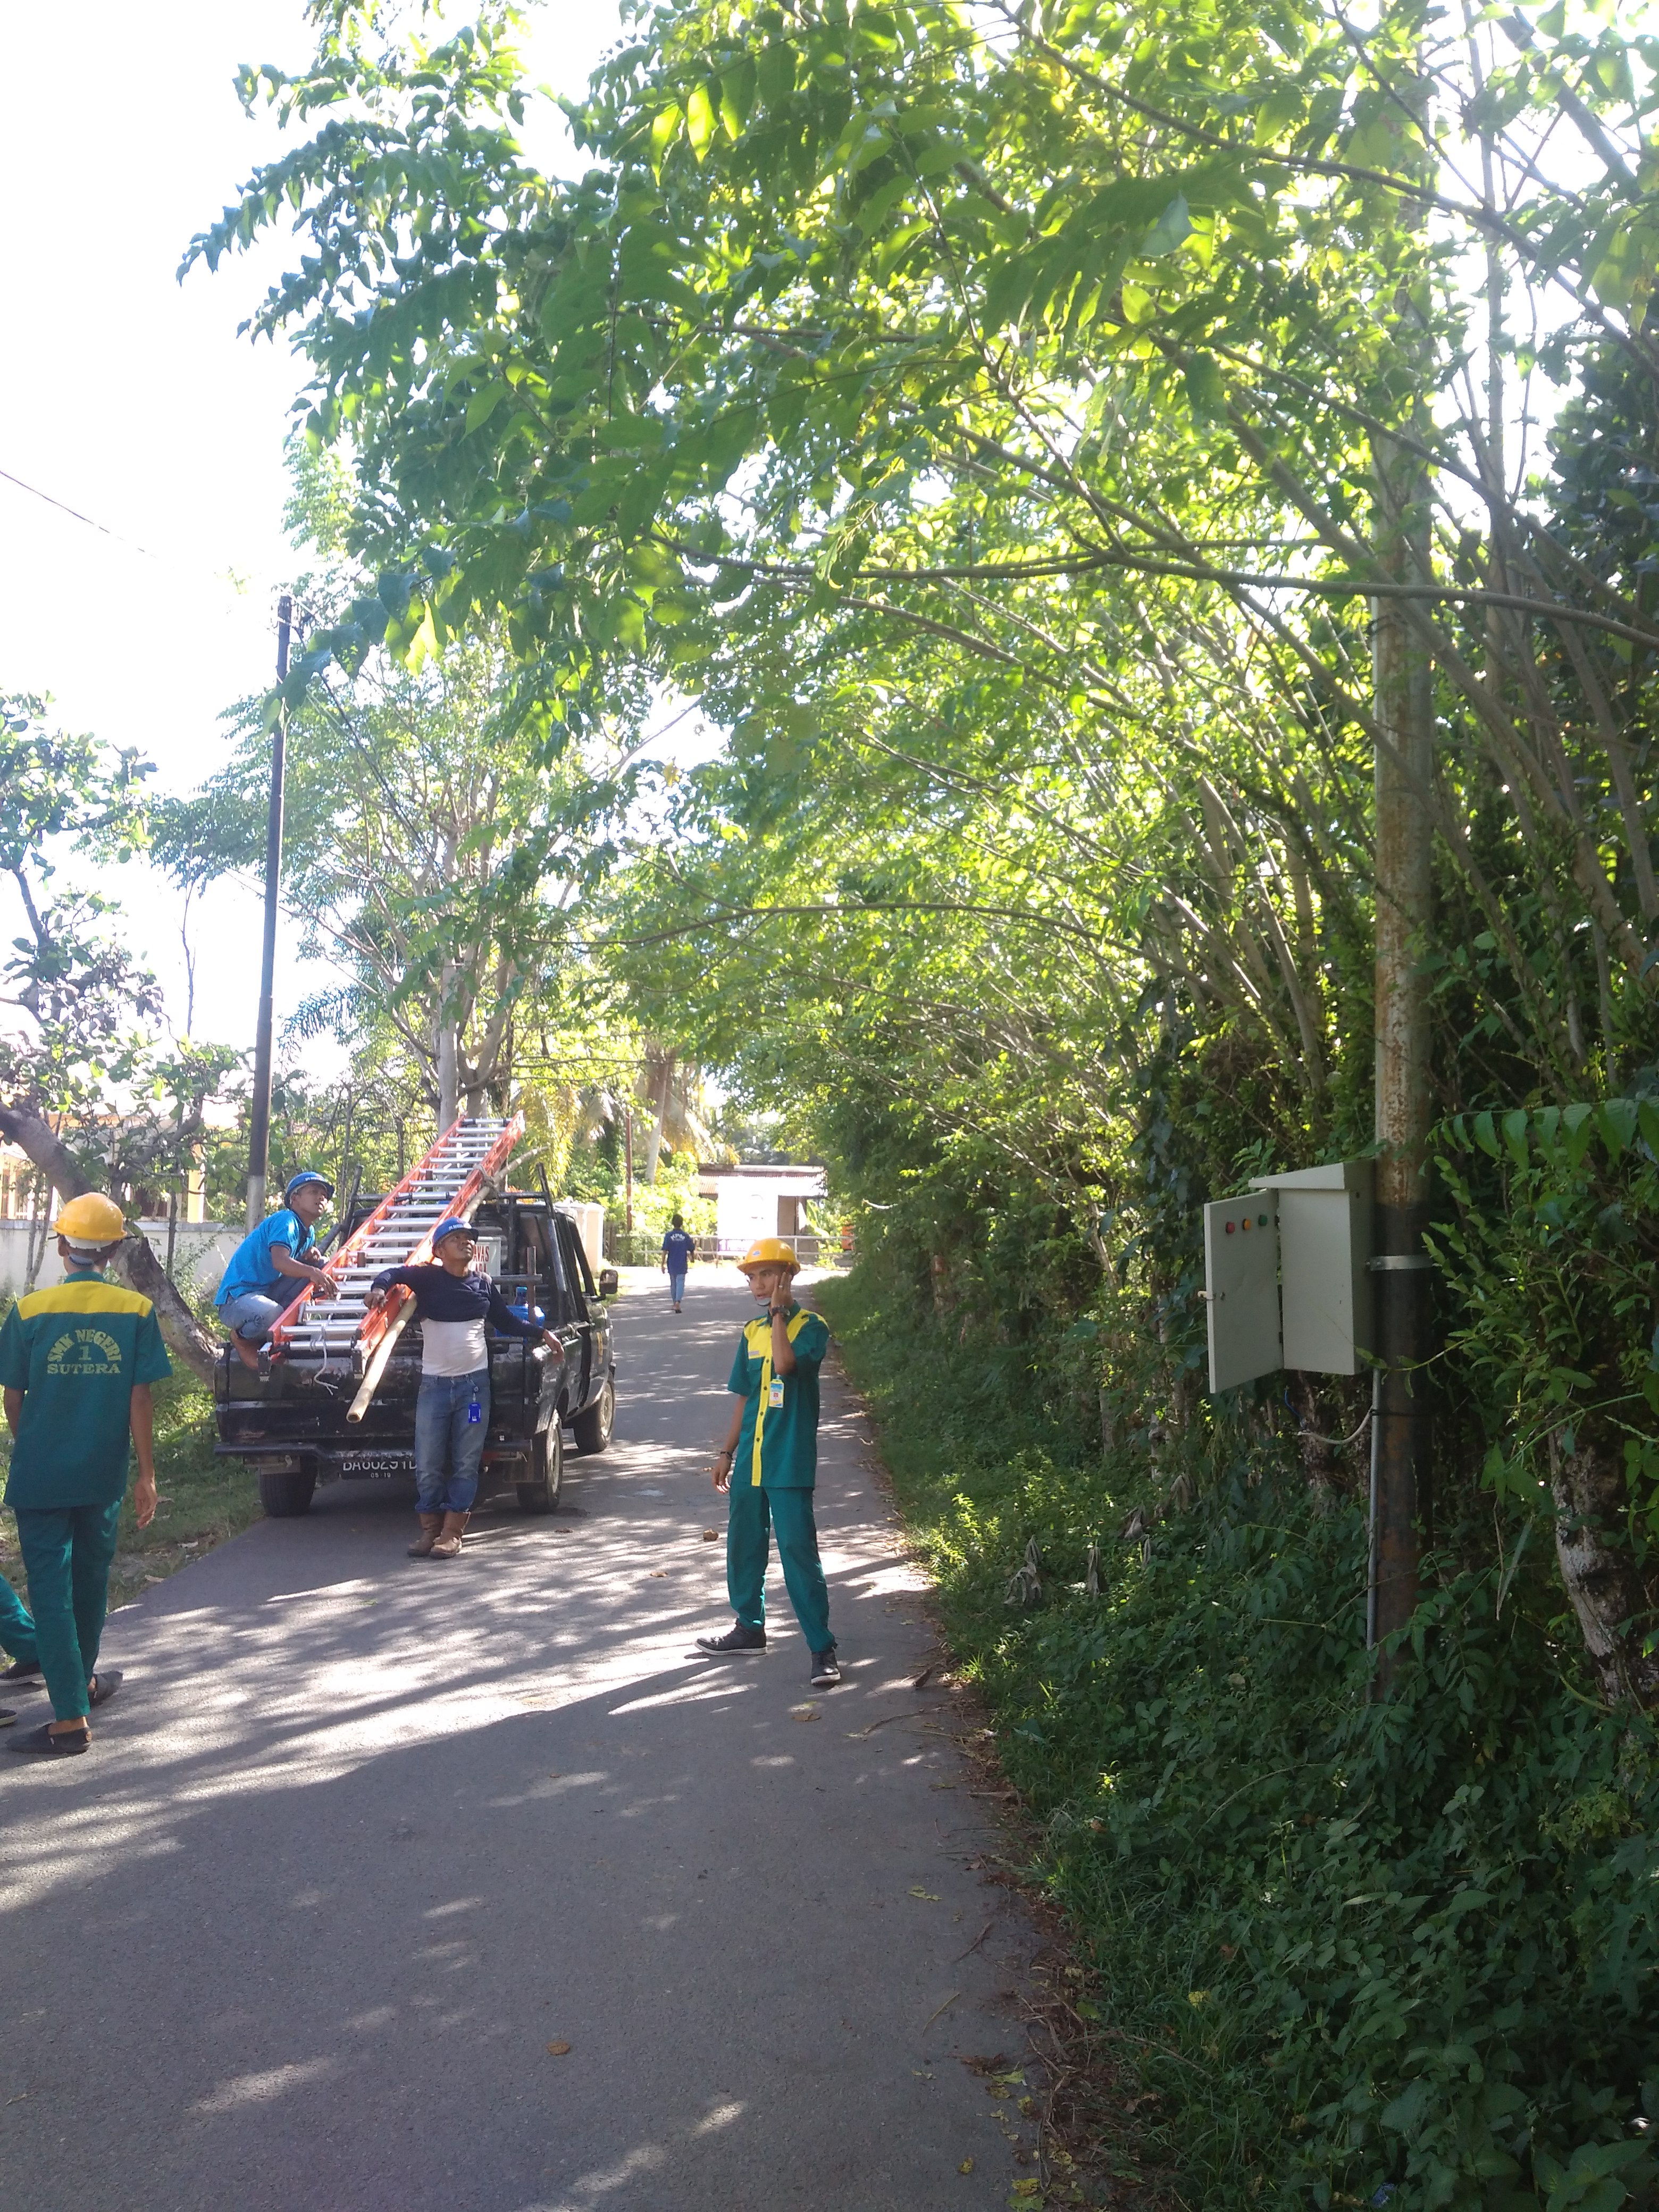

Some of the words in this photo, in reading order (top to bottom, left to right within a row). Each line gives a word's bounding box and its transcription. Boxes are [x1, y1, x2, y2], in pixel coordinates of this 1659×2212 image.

[47, 1333, 75, 1362] SMK
[76, 1329, 122, 1361] NEGERI
[79, 1345, 91, 1360] 1
[47, 1363, 121, 1374] SUTERA
